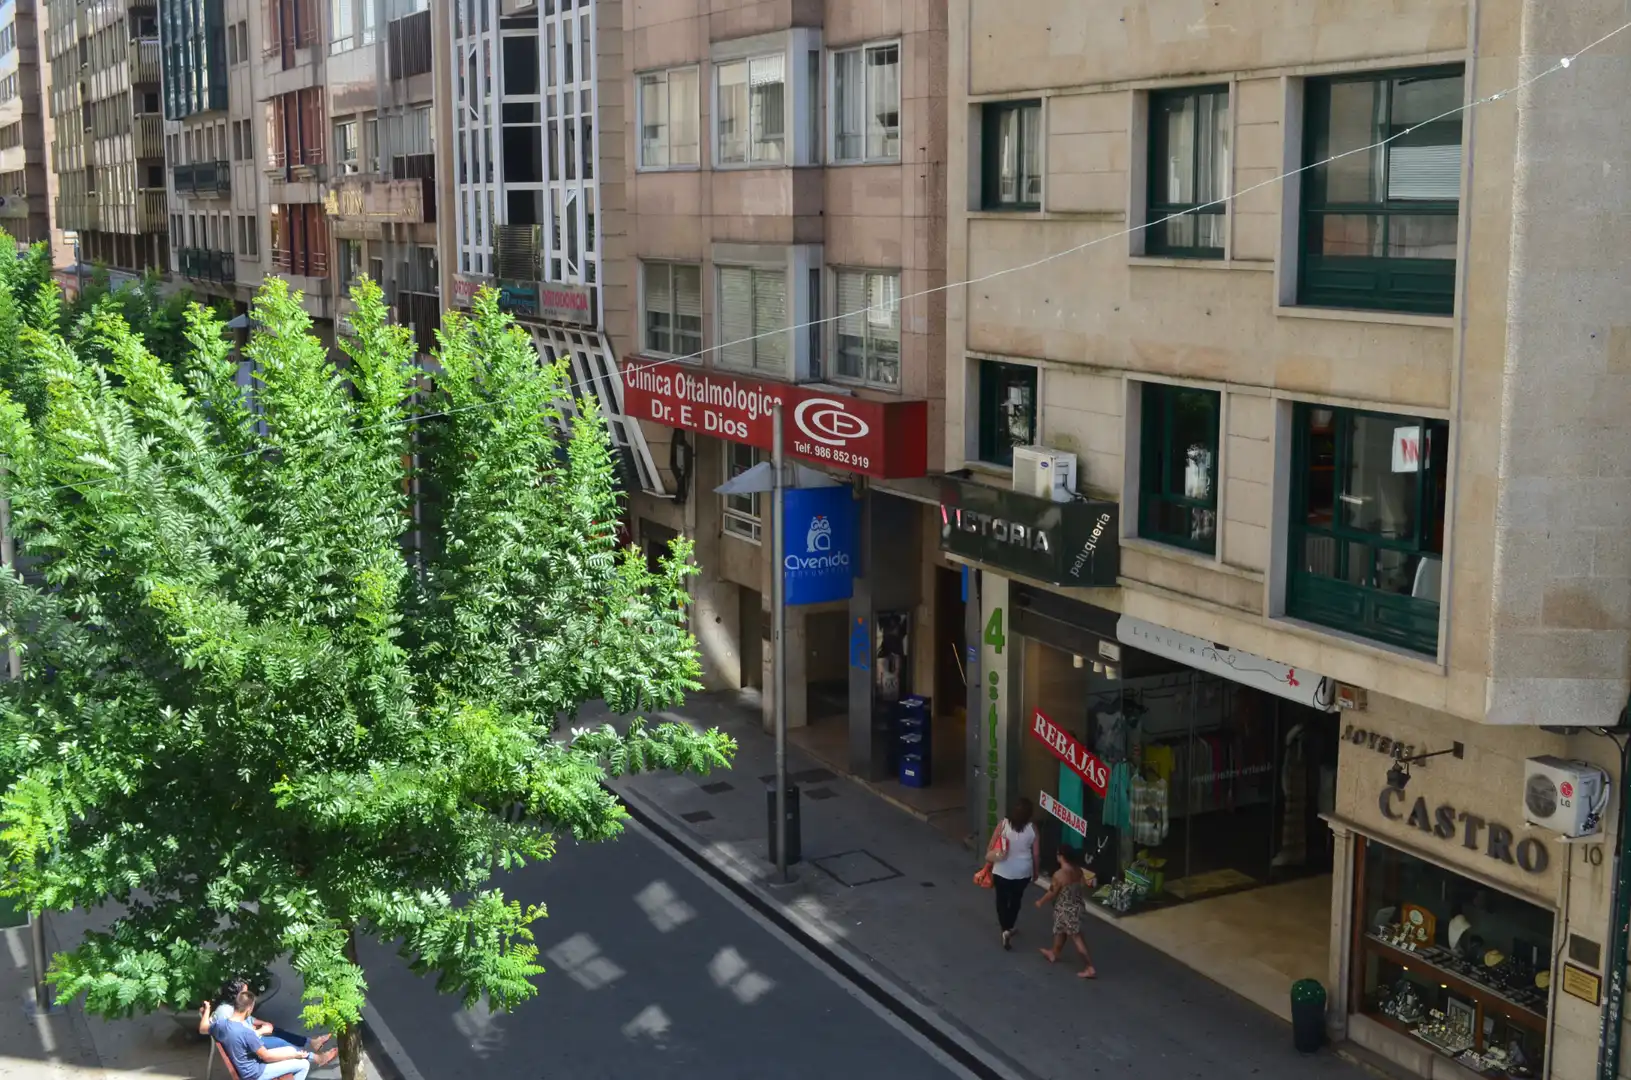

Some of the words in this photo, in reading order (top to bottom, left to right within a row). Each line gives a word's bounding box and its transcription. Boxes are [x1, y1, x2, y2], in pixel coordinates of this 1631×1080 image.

[651, 399, 675, 422] Dr.
[680, 405, 698, 428] E.
[704, 410, 748, 438] Dios
[793, 440, 813, 455] Telf.
[814, 445, 831, 459] 986
[833, 449, 850, 464] 852
[851, 454, 869, 469] 919
[940, 504, 1051, 553] VICTORIA
[984, 607, 1005, 655] 4
[1033, 712, 1108, 789] REBAJAS
[1052, 800, 1086, 834] REBAJAS
[1560, 798, 1571, 808] LG
[1378, 786, 1549, 873] CASTRO
[1582, 843, 1603, 866] 10
